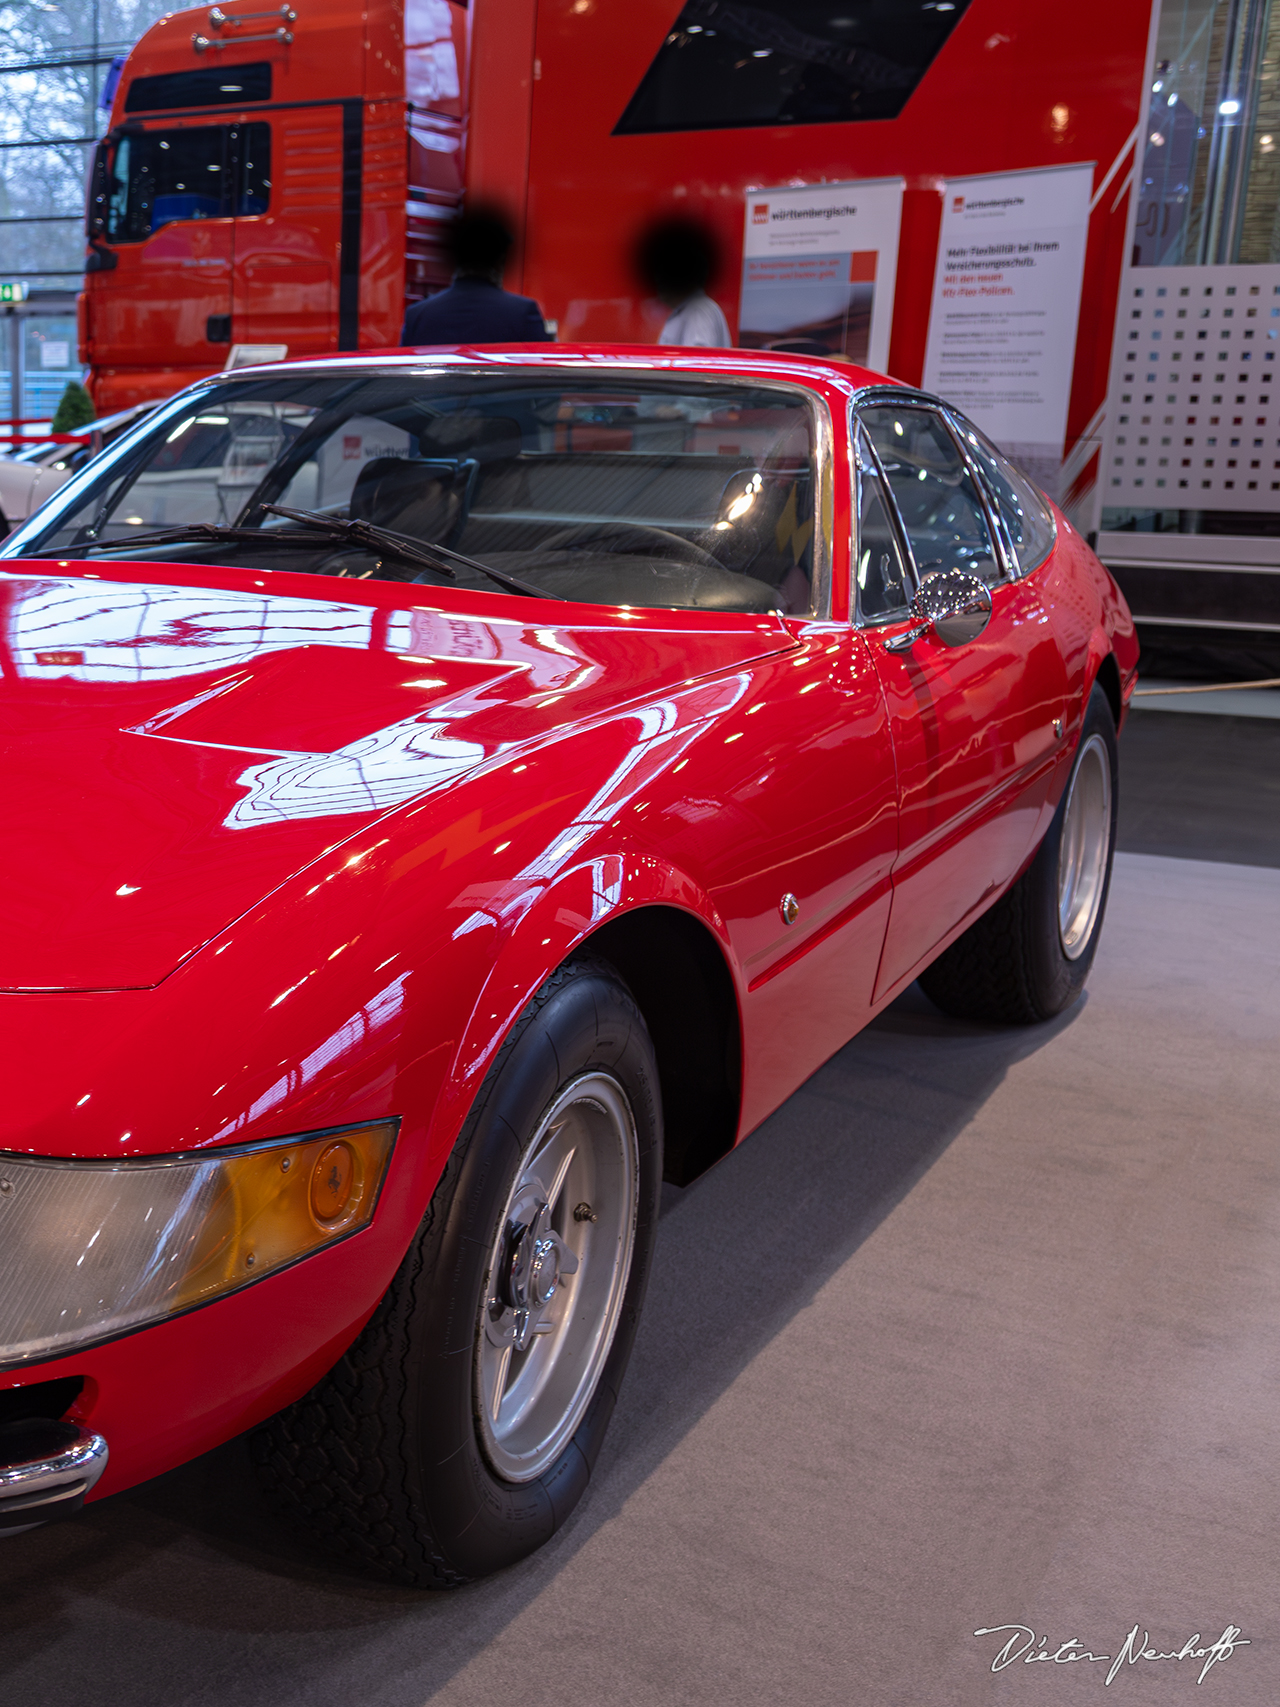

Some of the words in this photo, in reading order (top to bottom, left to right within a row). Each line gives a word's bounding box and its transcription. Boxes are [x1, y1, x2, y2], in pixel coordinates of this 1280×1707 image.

[772, 204, 857, 221] württembergische
[946, 246, 967, 257] Mehr
[970, 243, 1016, 257] Flexibilität
